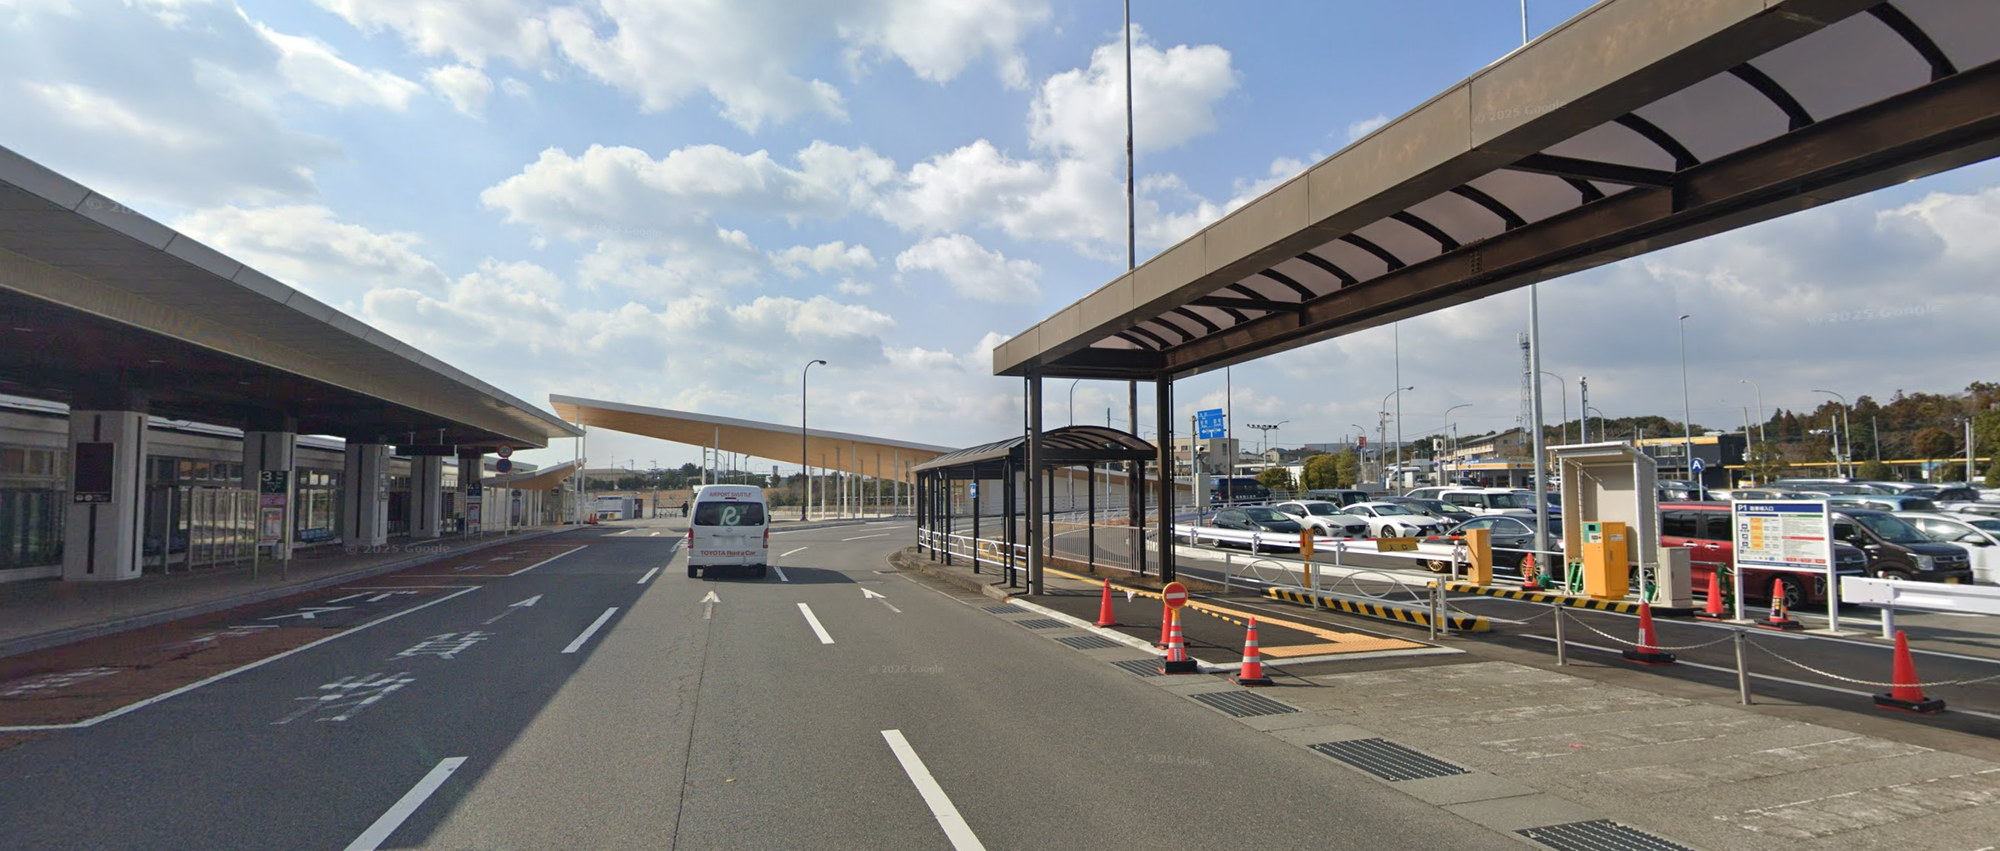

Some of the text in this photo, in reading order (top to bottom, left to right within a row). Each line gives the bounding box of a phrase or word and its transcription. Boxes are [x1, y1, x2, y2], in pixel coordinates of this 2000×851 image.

[1692, 460, 1701, 469] A
[262, 471, 272, 481] 3
[1737, 504, 1748, 512] P1
